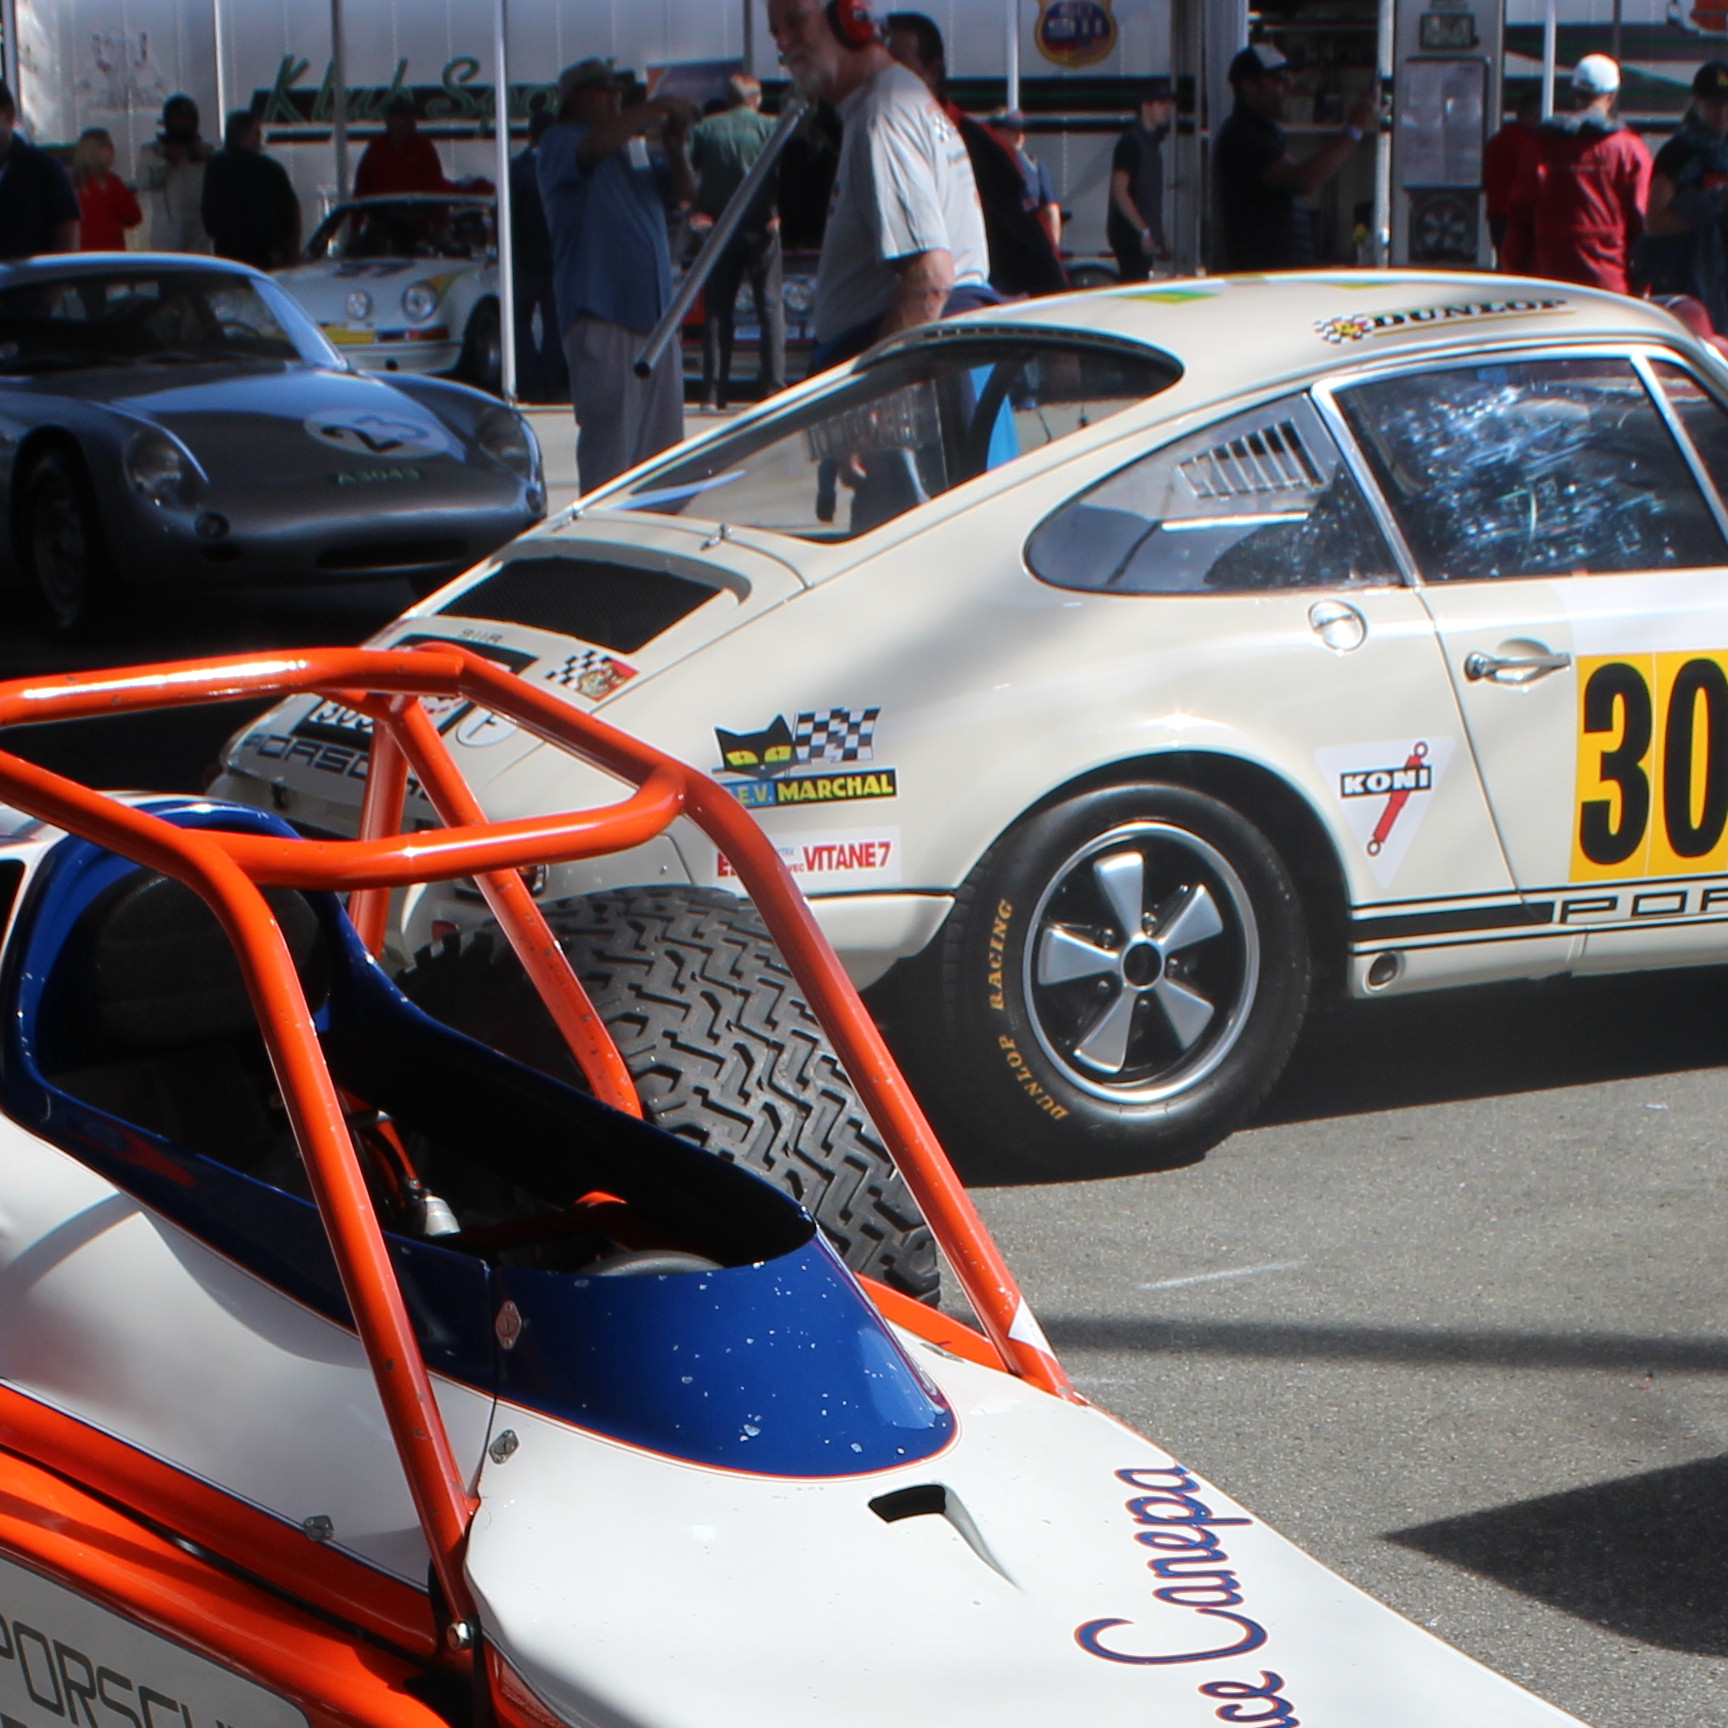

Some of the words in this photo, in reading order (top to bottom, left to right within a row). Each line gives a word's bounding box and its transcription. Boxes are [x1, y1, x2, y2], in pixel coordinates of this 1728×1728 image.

[1373, 299, 1568, 327] DUNLOP
[776, 774, 895, 802] MARCHAL
[1343, 768, 1429, 796] KONI
[987, 898, 1014, 1011] RACING
[998, 1034, 1070, 1121] DUNLOP
[1074, 1463, 1268, 1665] Canepa
